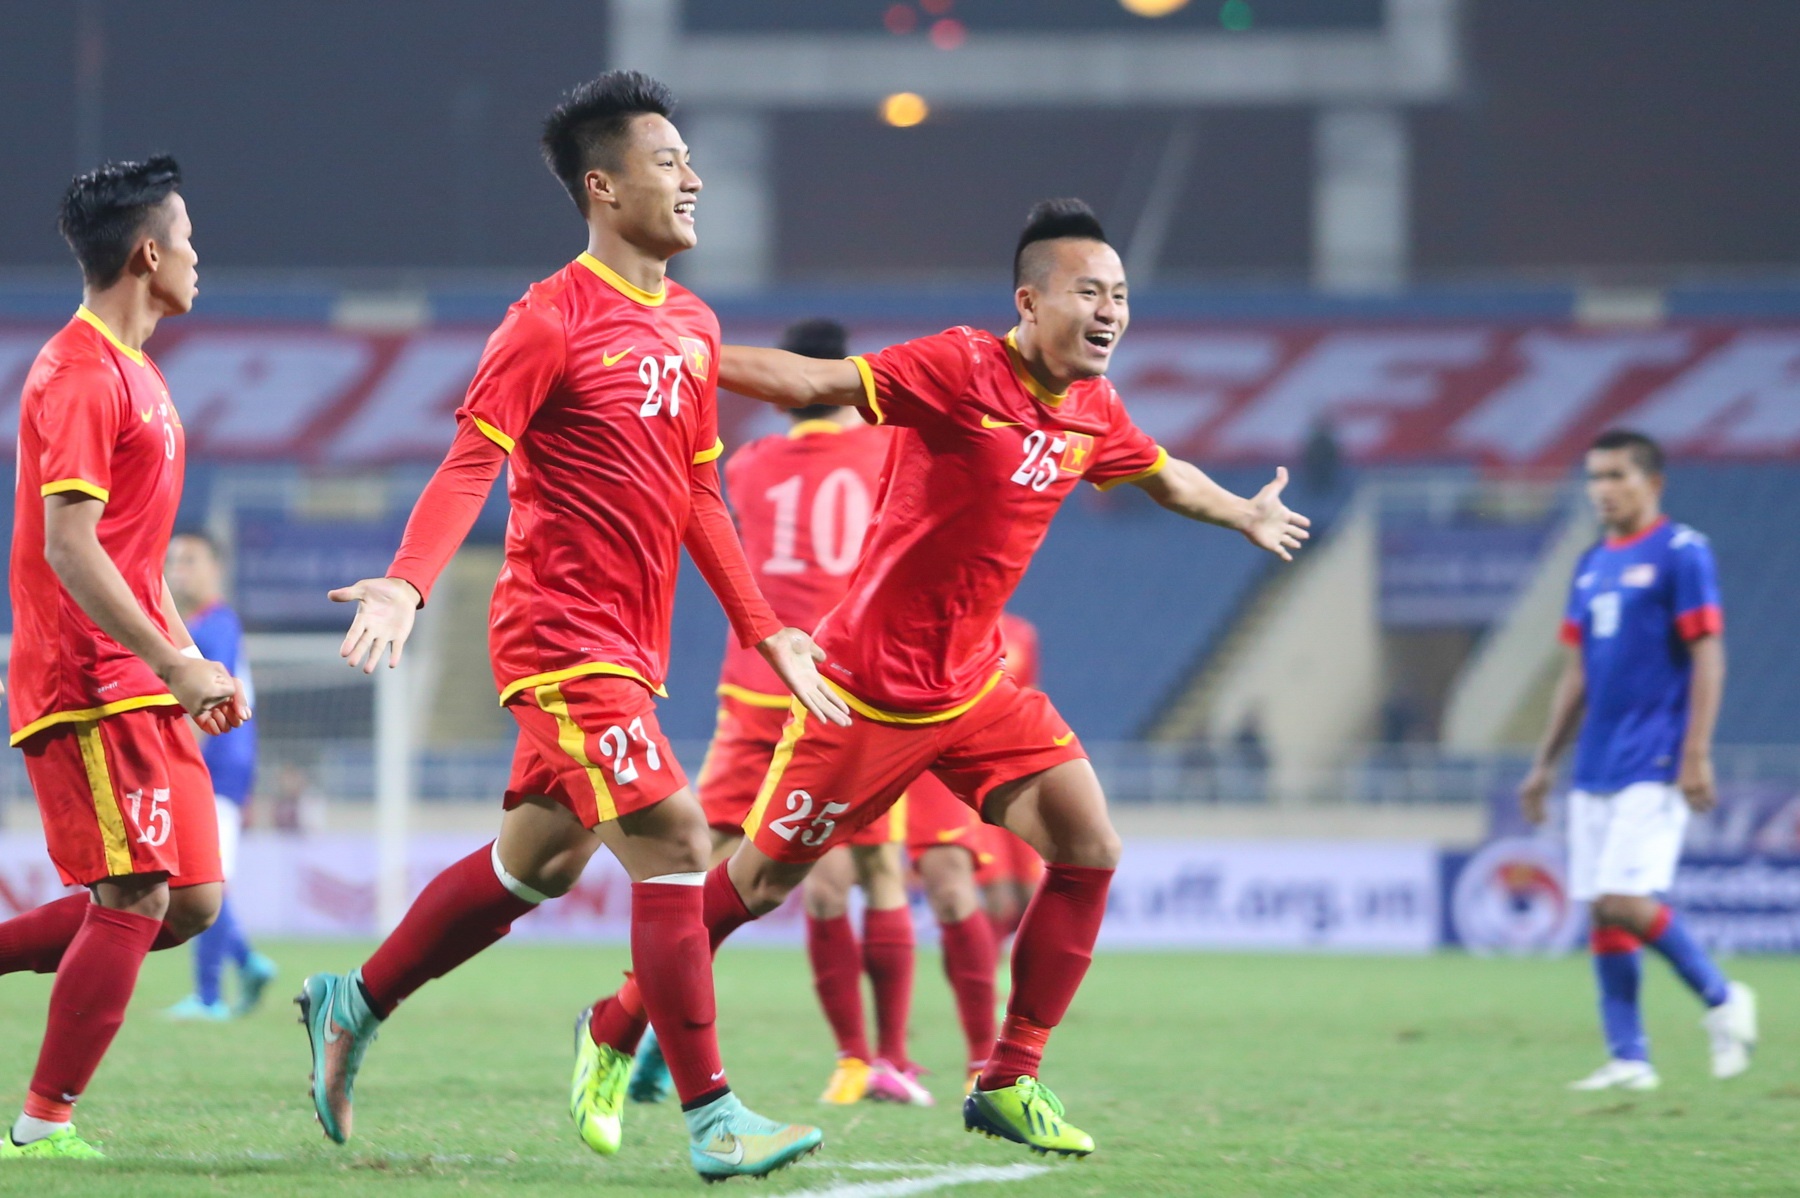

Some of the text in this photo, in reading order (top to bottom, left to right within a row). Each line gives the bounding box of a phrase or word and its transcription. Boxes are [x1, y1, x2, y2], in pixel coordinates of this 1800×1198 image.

[639, 355, 683, 417] 27
[1010, 430, 1067, 492] 25
[763, 467, 872, 576] 10
[599, 716, 661, 786] 27
[126, 788, 171, 847] 15
[768, 789, 850, 847] 25
